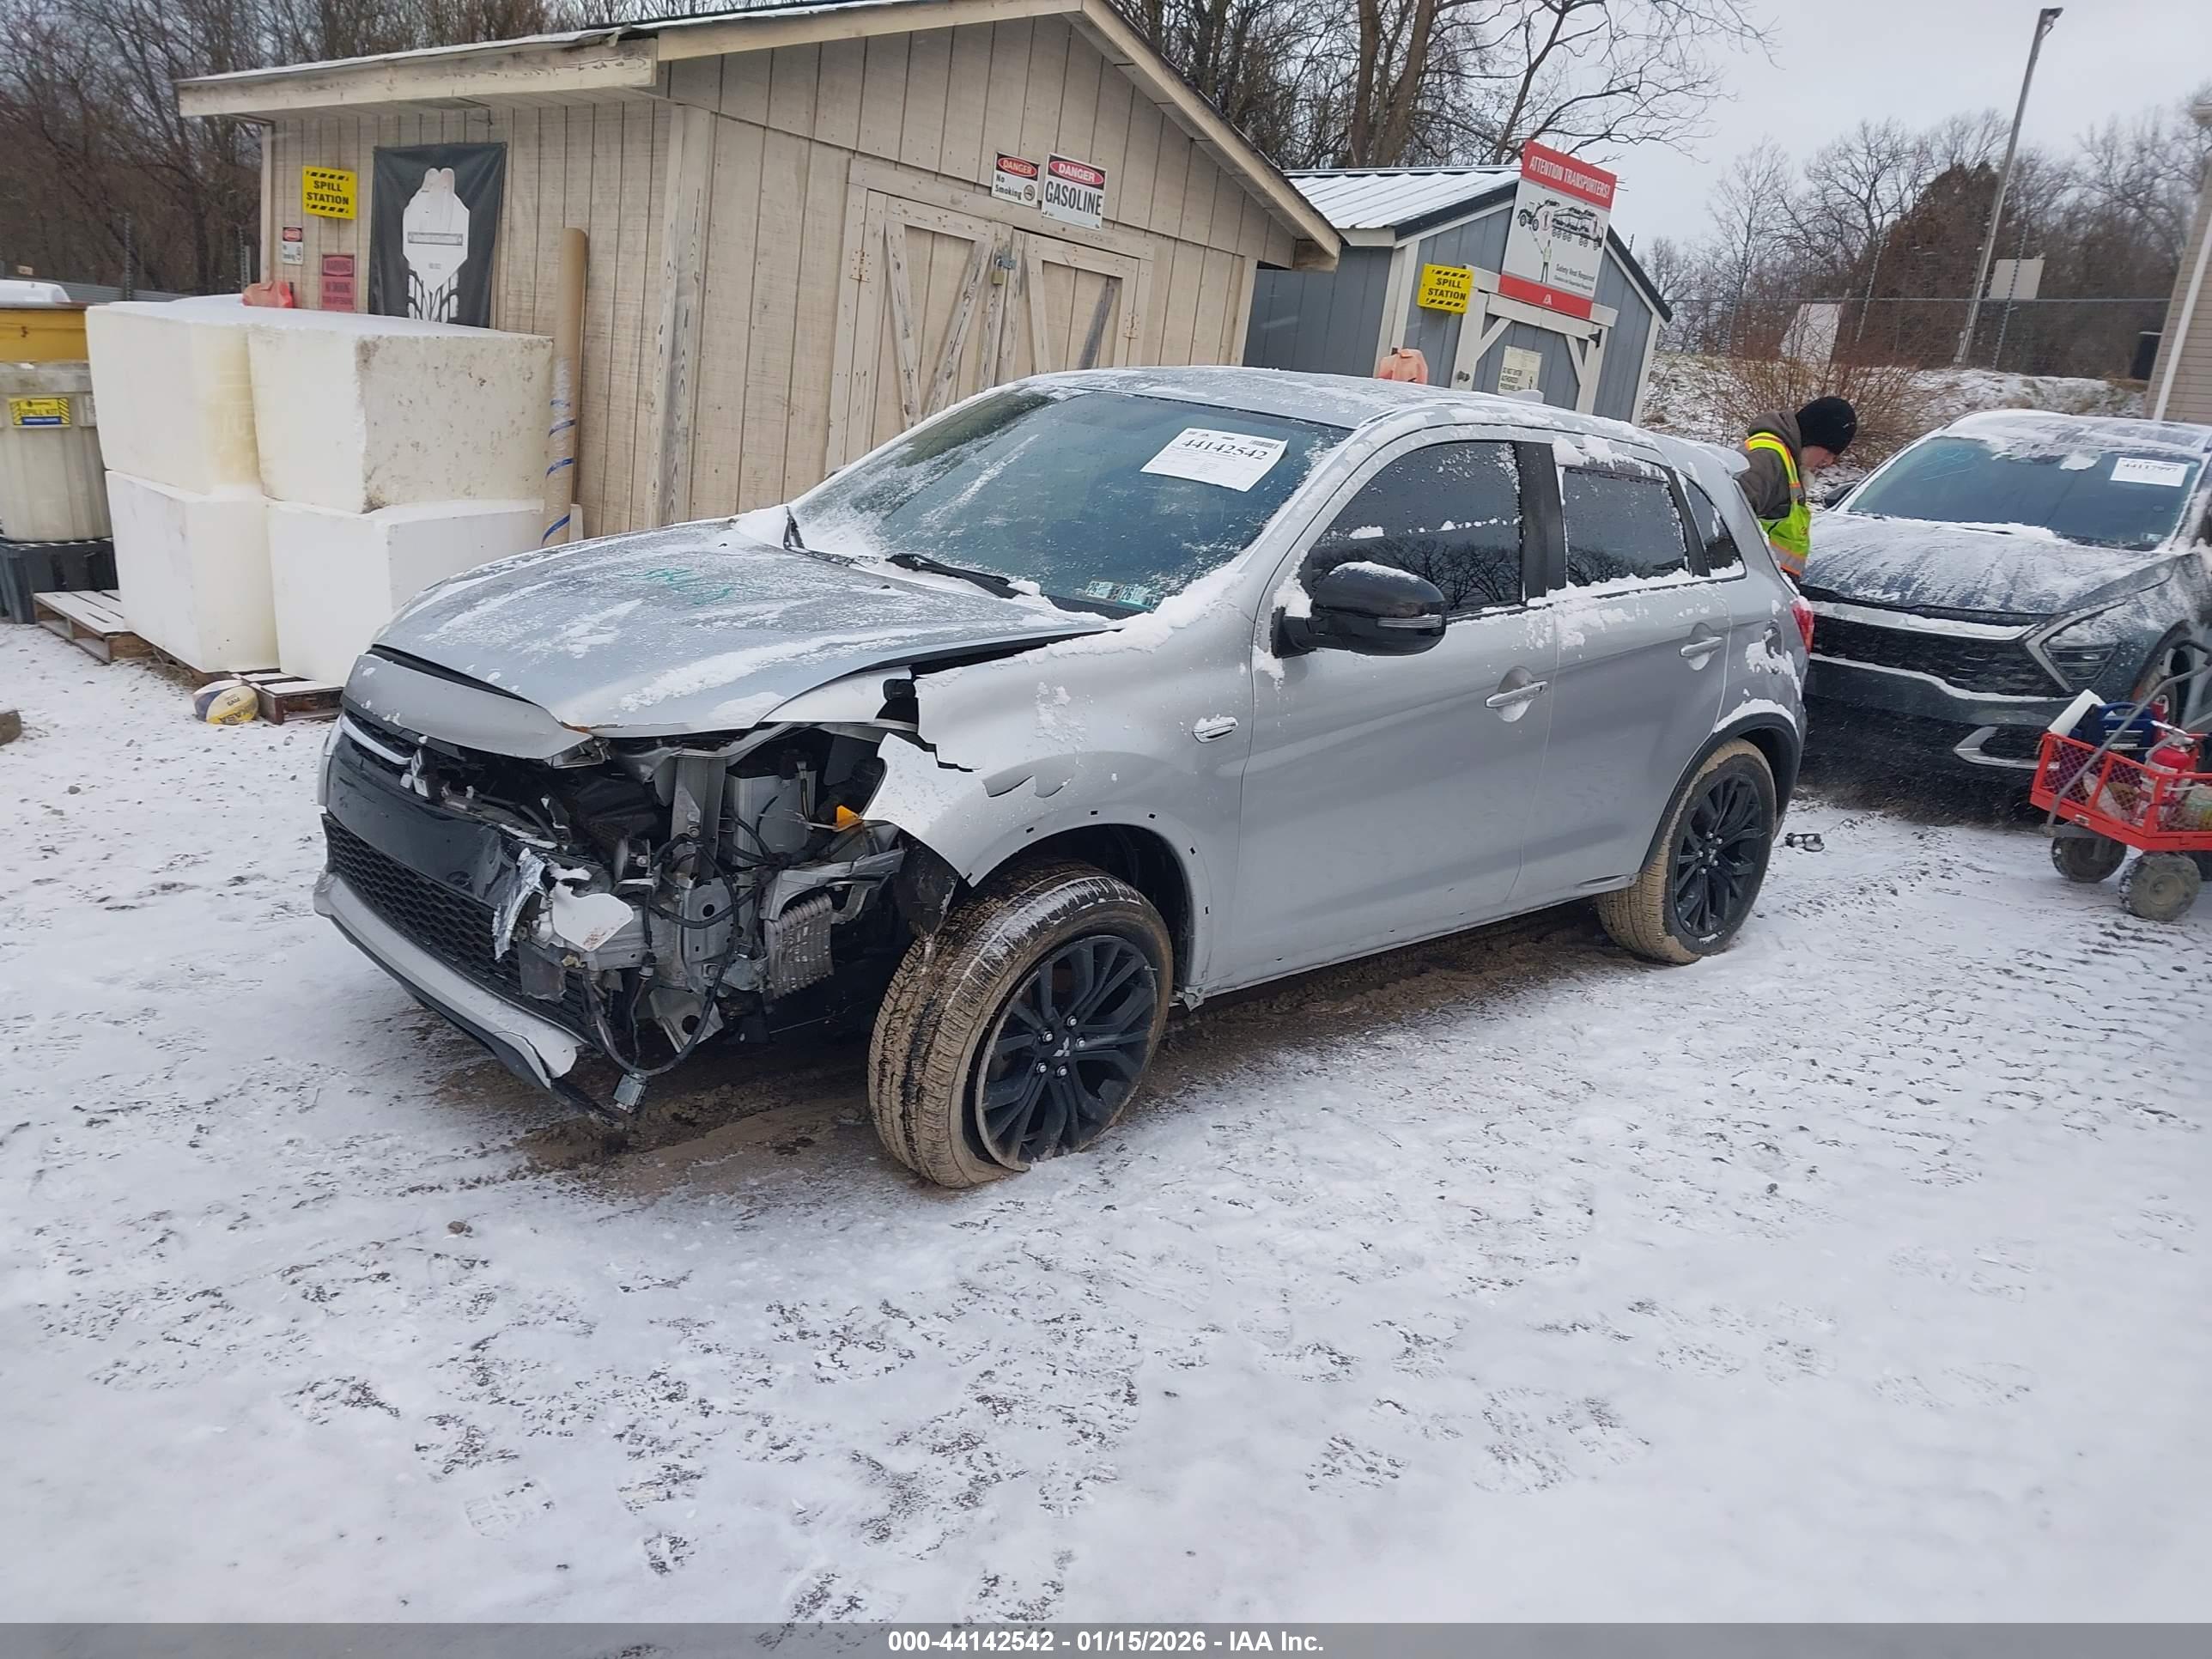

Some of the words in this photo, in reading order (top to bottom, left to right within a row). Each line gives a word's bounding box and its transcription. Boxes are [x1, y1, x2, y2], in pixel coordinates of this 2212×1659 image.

[1002, 160, 1031, 174] DANGER
[1058, 163, 1096, 183] DANGER
[996, 174, 1005, 183] No
[1528, 155, 1564, 181] ATTENTION
[1564, 167, 1611, 198] TRANSPORTERS!
[313, 180, 343, 192] SPILL
[995, 185, 1023, 201] Smoking
[307, 191, 349, 205] STATION
[1045, 180, 1103, 216] GASOLINE
[1435, 277, 1462, 289] SPILL
[1427, 288, 1467, 301] STATION
[1181, 439, 1269, 460] 44142542
